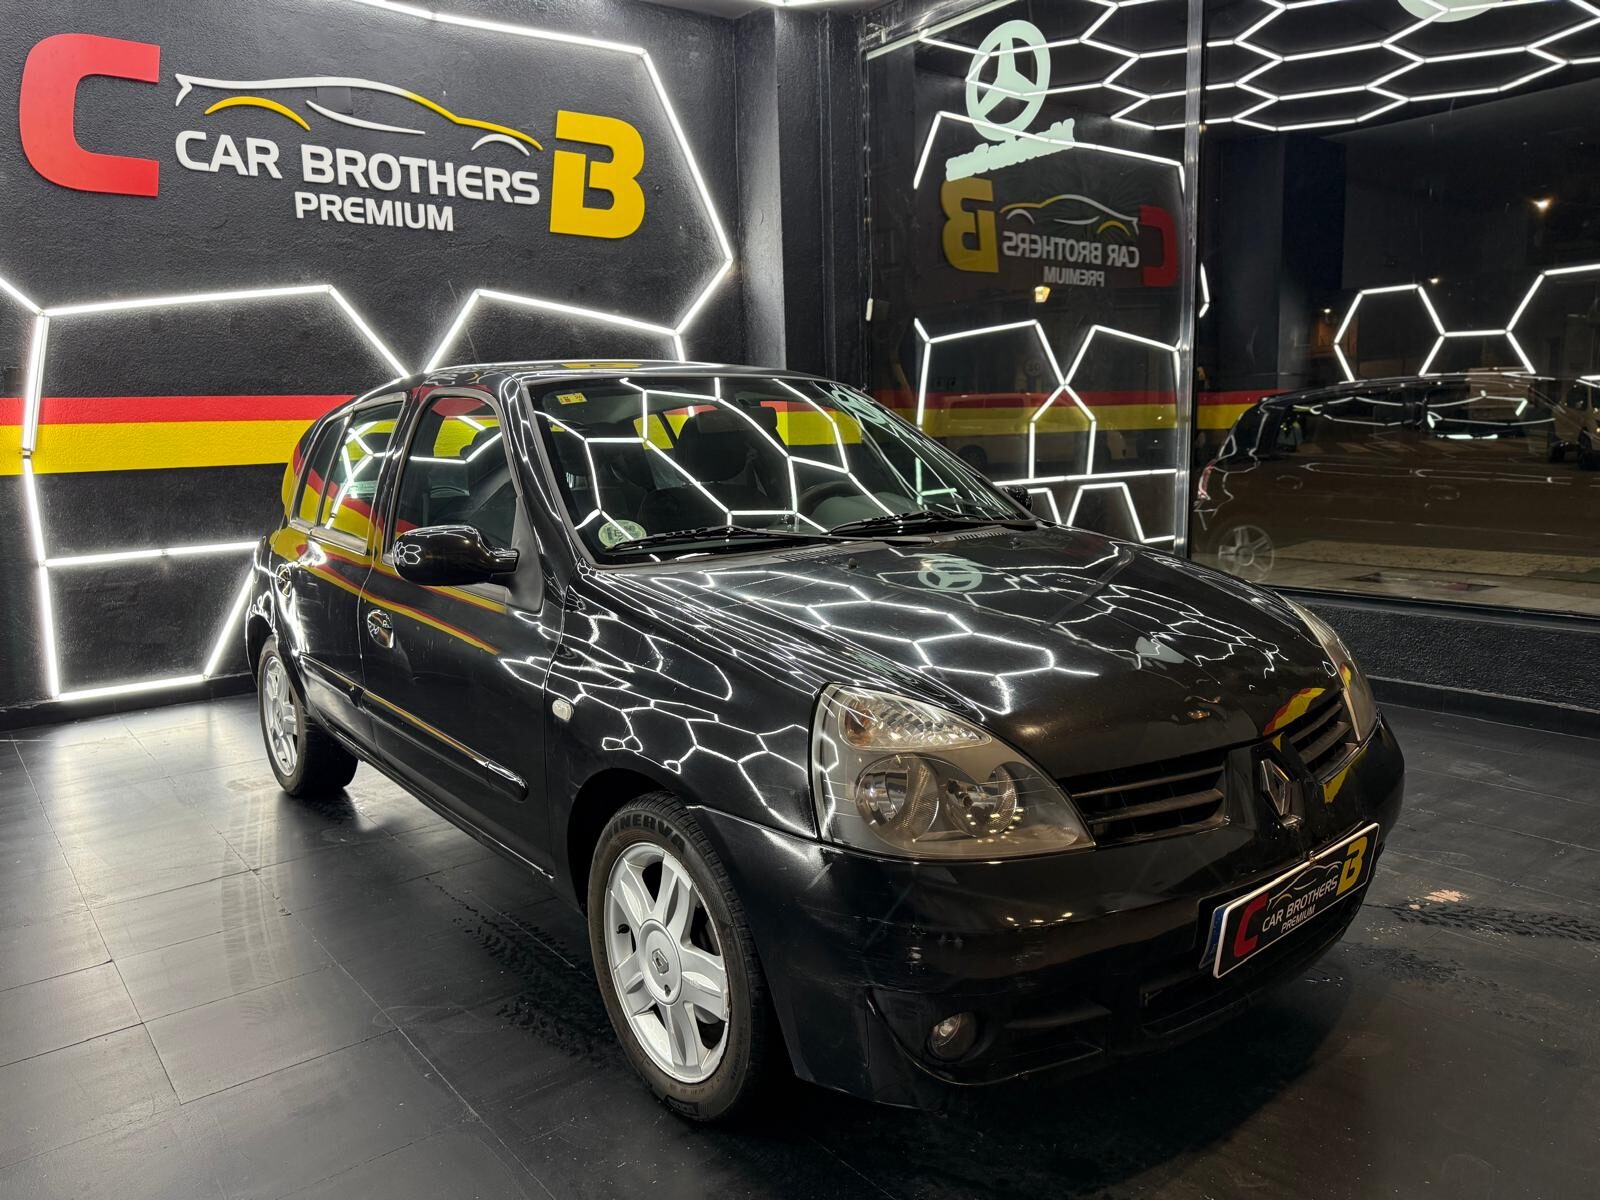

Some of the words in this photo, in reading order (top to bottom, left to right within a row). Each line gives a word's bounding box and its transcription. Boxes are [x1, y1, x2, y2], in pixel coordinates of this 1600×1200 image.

[19, 33, 161, 198] C
[175, 130, 283, 180] CAR
[301, 143, 541, 206] BROTHERS
[549, 109, 646, 240] B
[294, 190, 454, 232] PREMIUM
[1335, 836, 1368, 897] B
[1233, 892, 1270, 958] C
[1262, 908, 1284, 933] CAR
[1286, 875, 1339, 918] BROTHERS
[1280, 904, 1316, 934] PREMIUM
